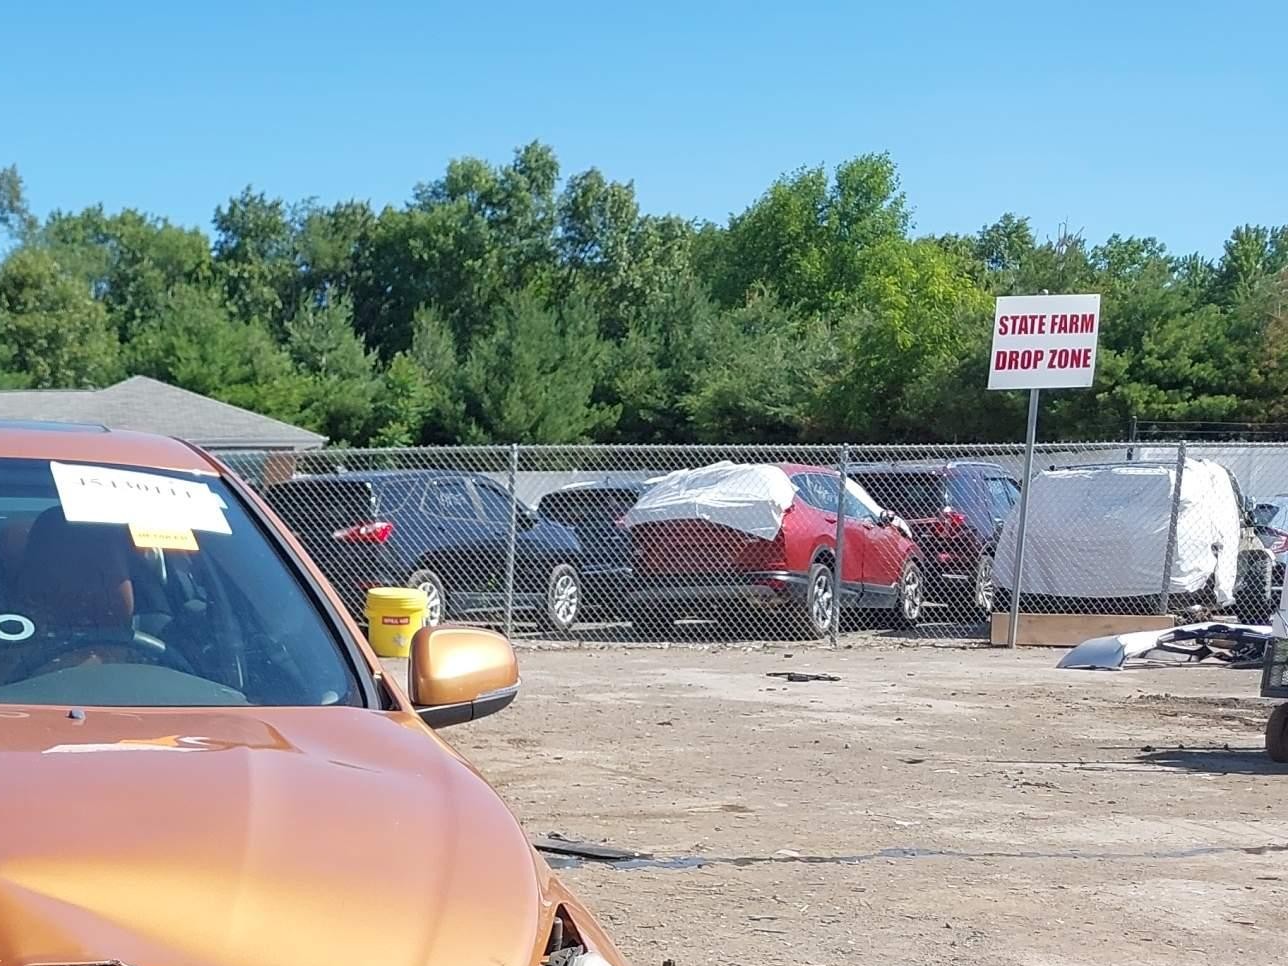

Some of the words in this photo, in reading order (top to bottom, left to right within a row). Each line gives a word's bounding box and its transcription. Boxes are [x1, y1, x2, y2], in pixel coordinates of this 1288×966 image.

[998, 314, 1047, 336] STATE
[1050, 313, 1095, 334] FARM
[994, 350, 1044, 370] DROP
[1047, 348, 1092, 369] ZONE
